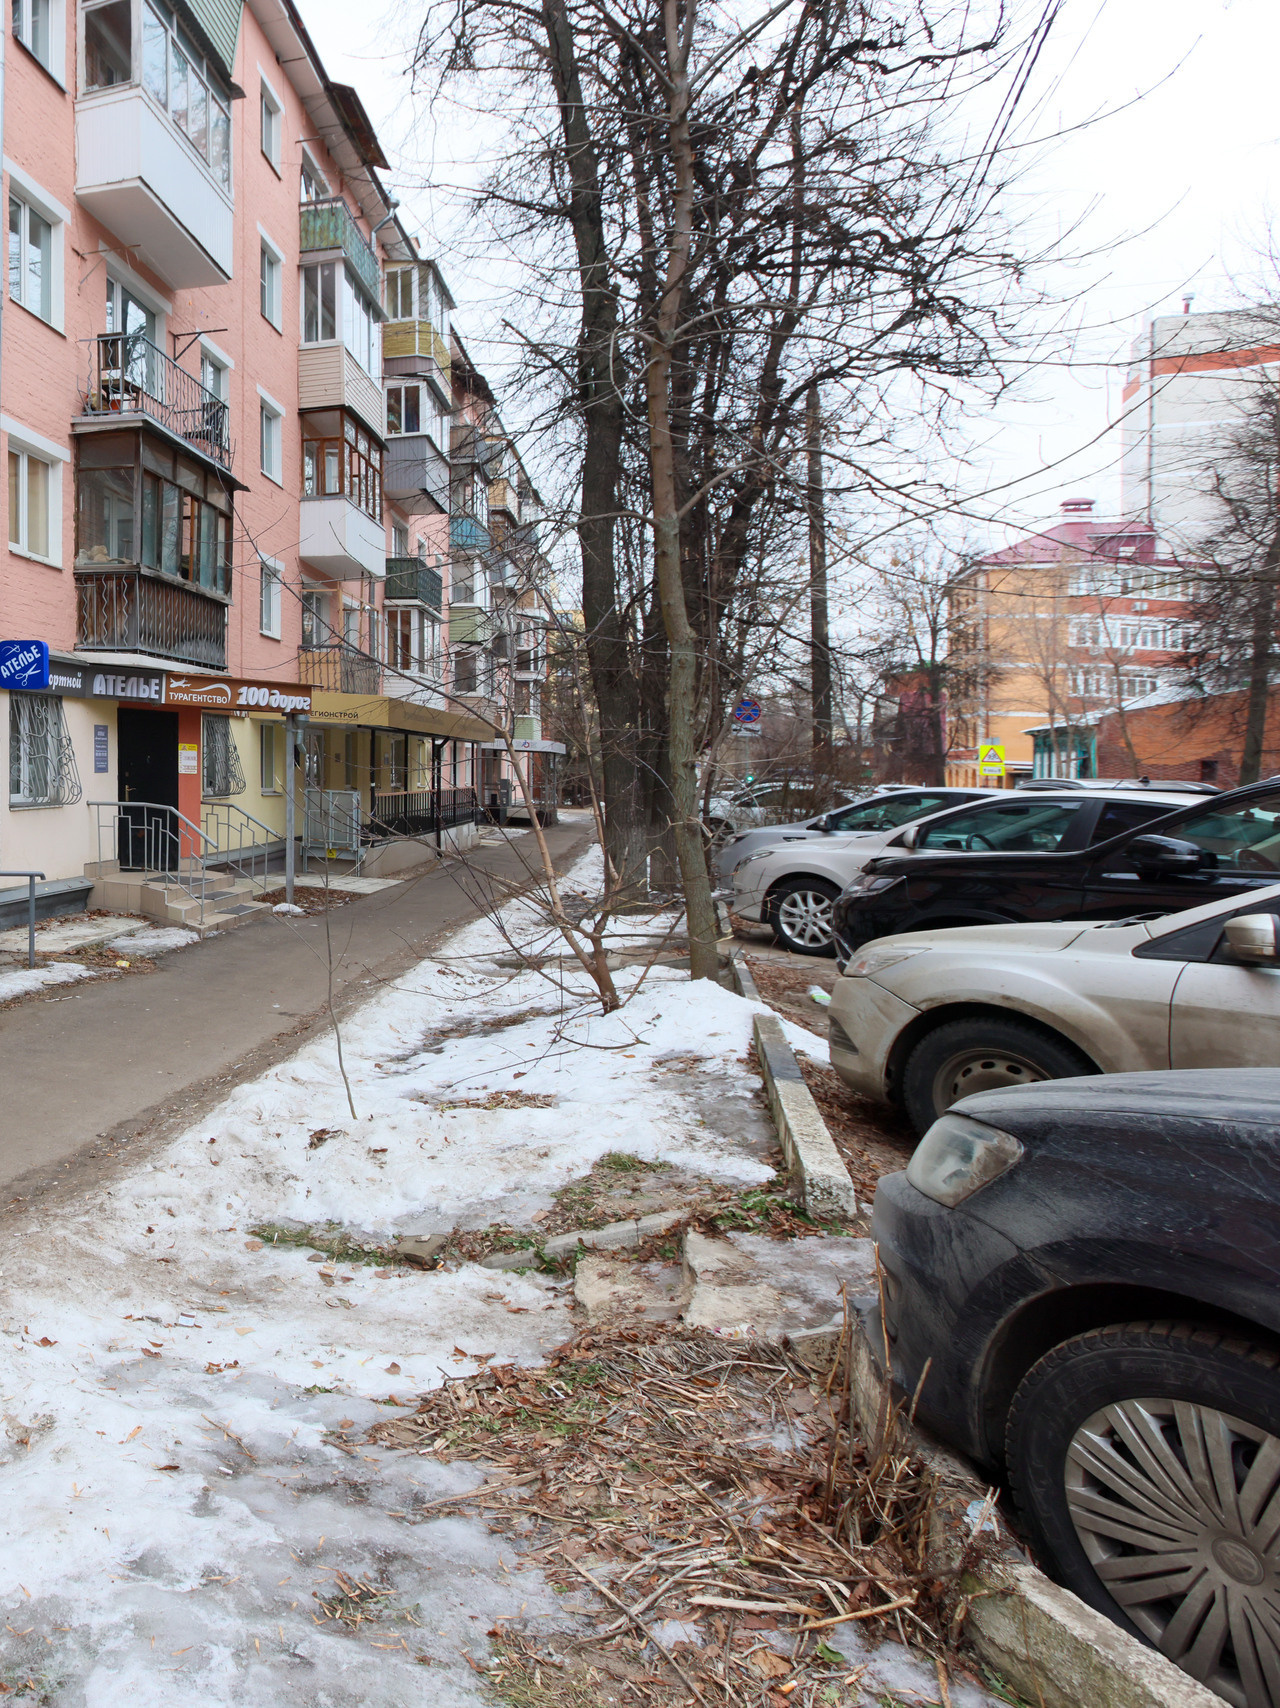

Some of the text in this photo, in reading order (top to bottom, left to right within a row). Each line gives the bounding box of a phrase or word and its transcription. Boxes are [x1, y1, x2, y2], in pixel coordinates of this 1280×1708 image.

[0, 645, 41, 679] АТЕЛЬЕ
[48, 672, 82, 690] ортной
[92, 673, 160, 699] АТЕЛЬЕ
[169, 691, 228, 704] ТУРАГЕНТСТВО
[236, 686, 311, 713] 100 дорог
[310, 710, 359, 719] ЕГИОНСТРОЙ
